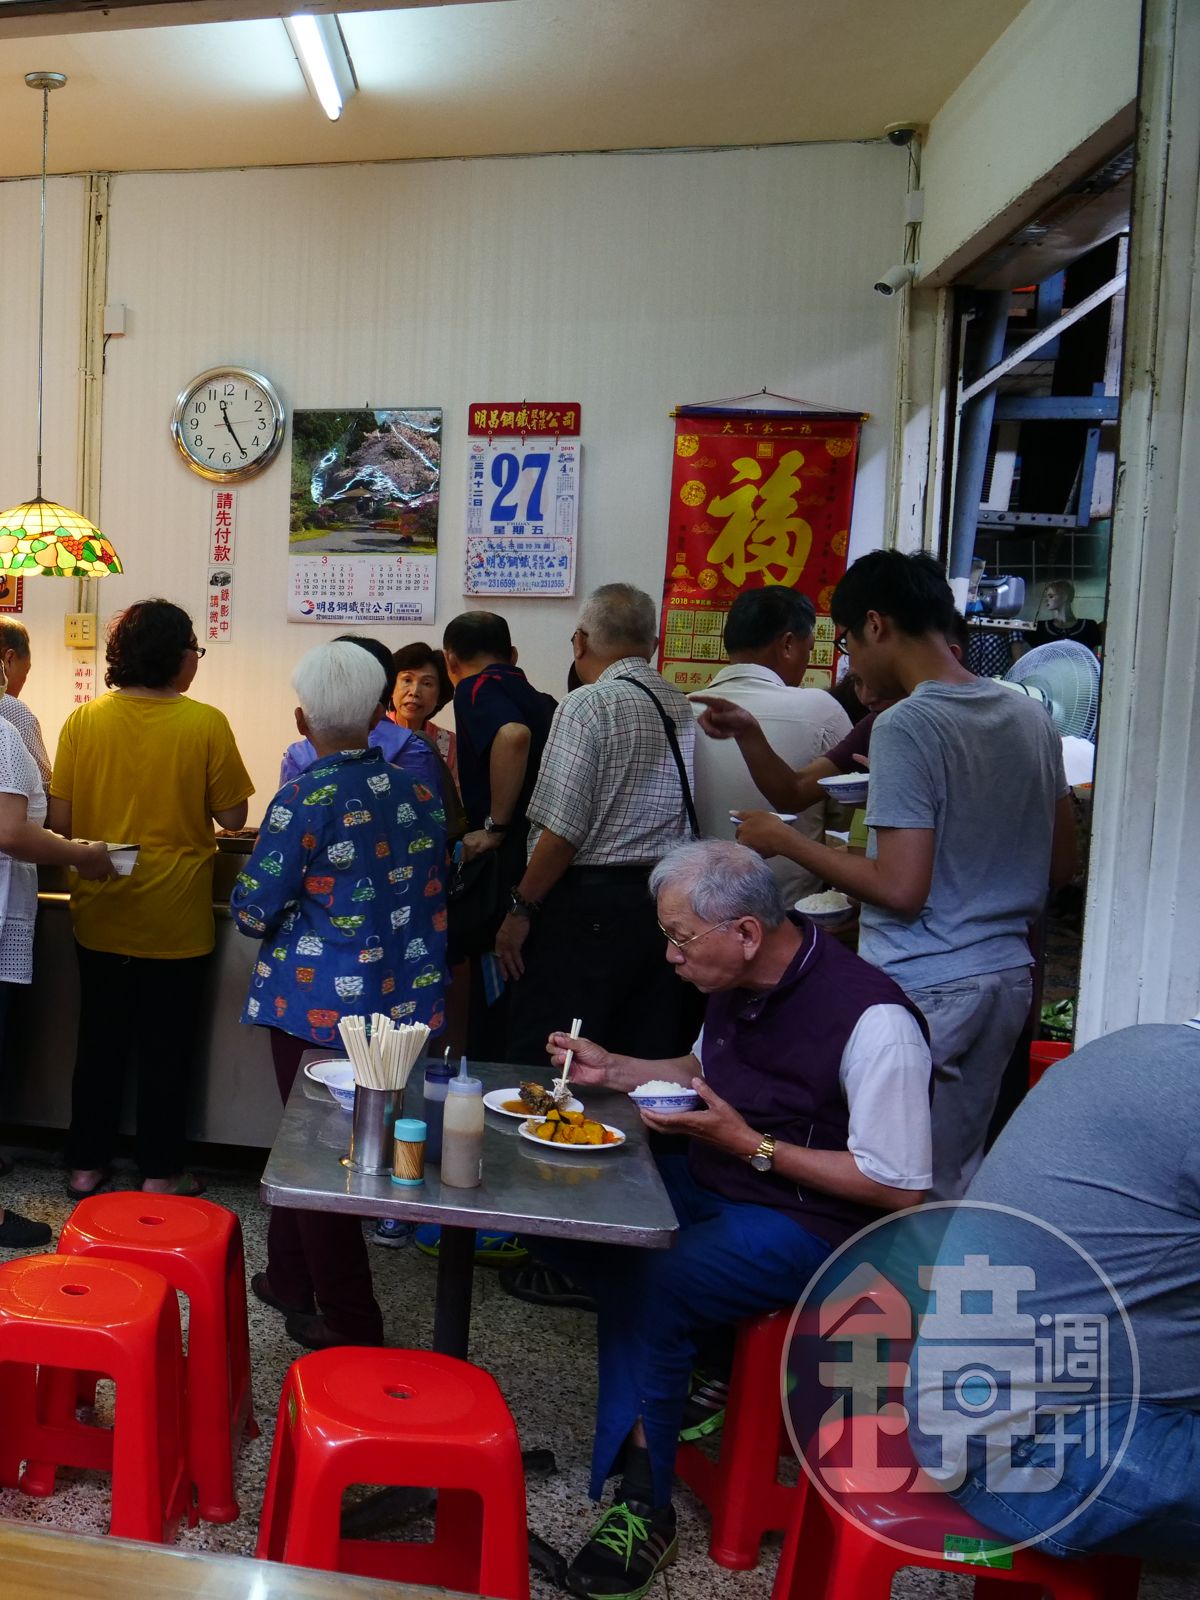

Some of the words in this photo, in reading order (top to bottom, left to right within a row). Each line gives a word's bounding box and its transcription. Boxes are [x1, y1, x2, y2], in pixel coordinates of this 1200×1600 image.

[209, 389, 217, 400] 11
[224, 384, 235, 396] 12
[195, 402, 206, 413] 10
[254, 400, 263, 412] 2
[190, 418, 199, 430] 9
[257, 418, 266, 430] 3
[194, 435, 203, 447] 8
[251, 436, 259, 447] 4
[207, 448, 215, 459] 7
[222, 452, 231, 463] 6
[239, 448, 247, 459] 5
[473, 462, 484, 506] 三月十二日
[490, 453, 551, 521] 27
[706, 450, 813, 588] 福
[213, 492, 233, 562] 請先付款
[494, 526, 544, 534] 星期五
[321, 556, 328, 564] 3
[396, 557, 402, 565] 4
[488, 579, 516, 588] 2316599
[671, 597, 688, 605] 2018
[219, 588, 230, 633] 錄影中
[209, 595, 219, 640] 請微笑
